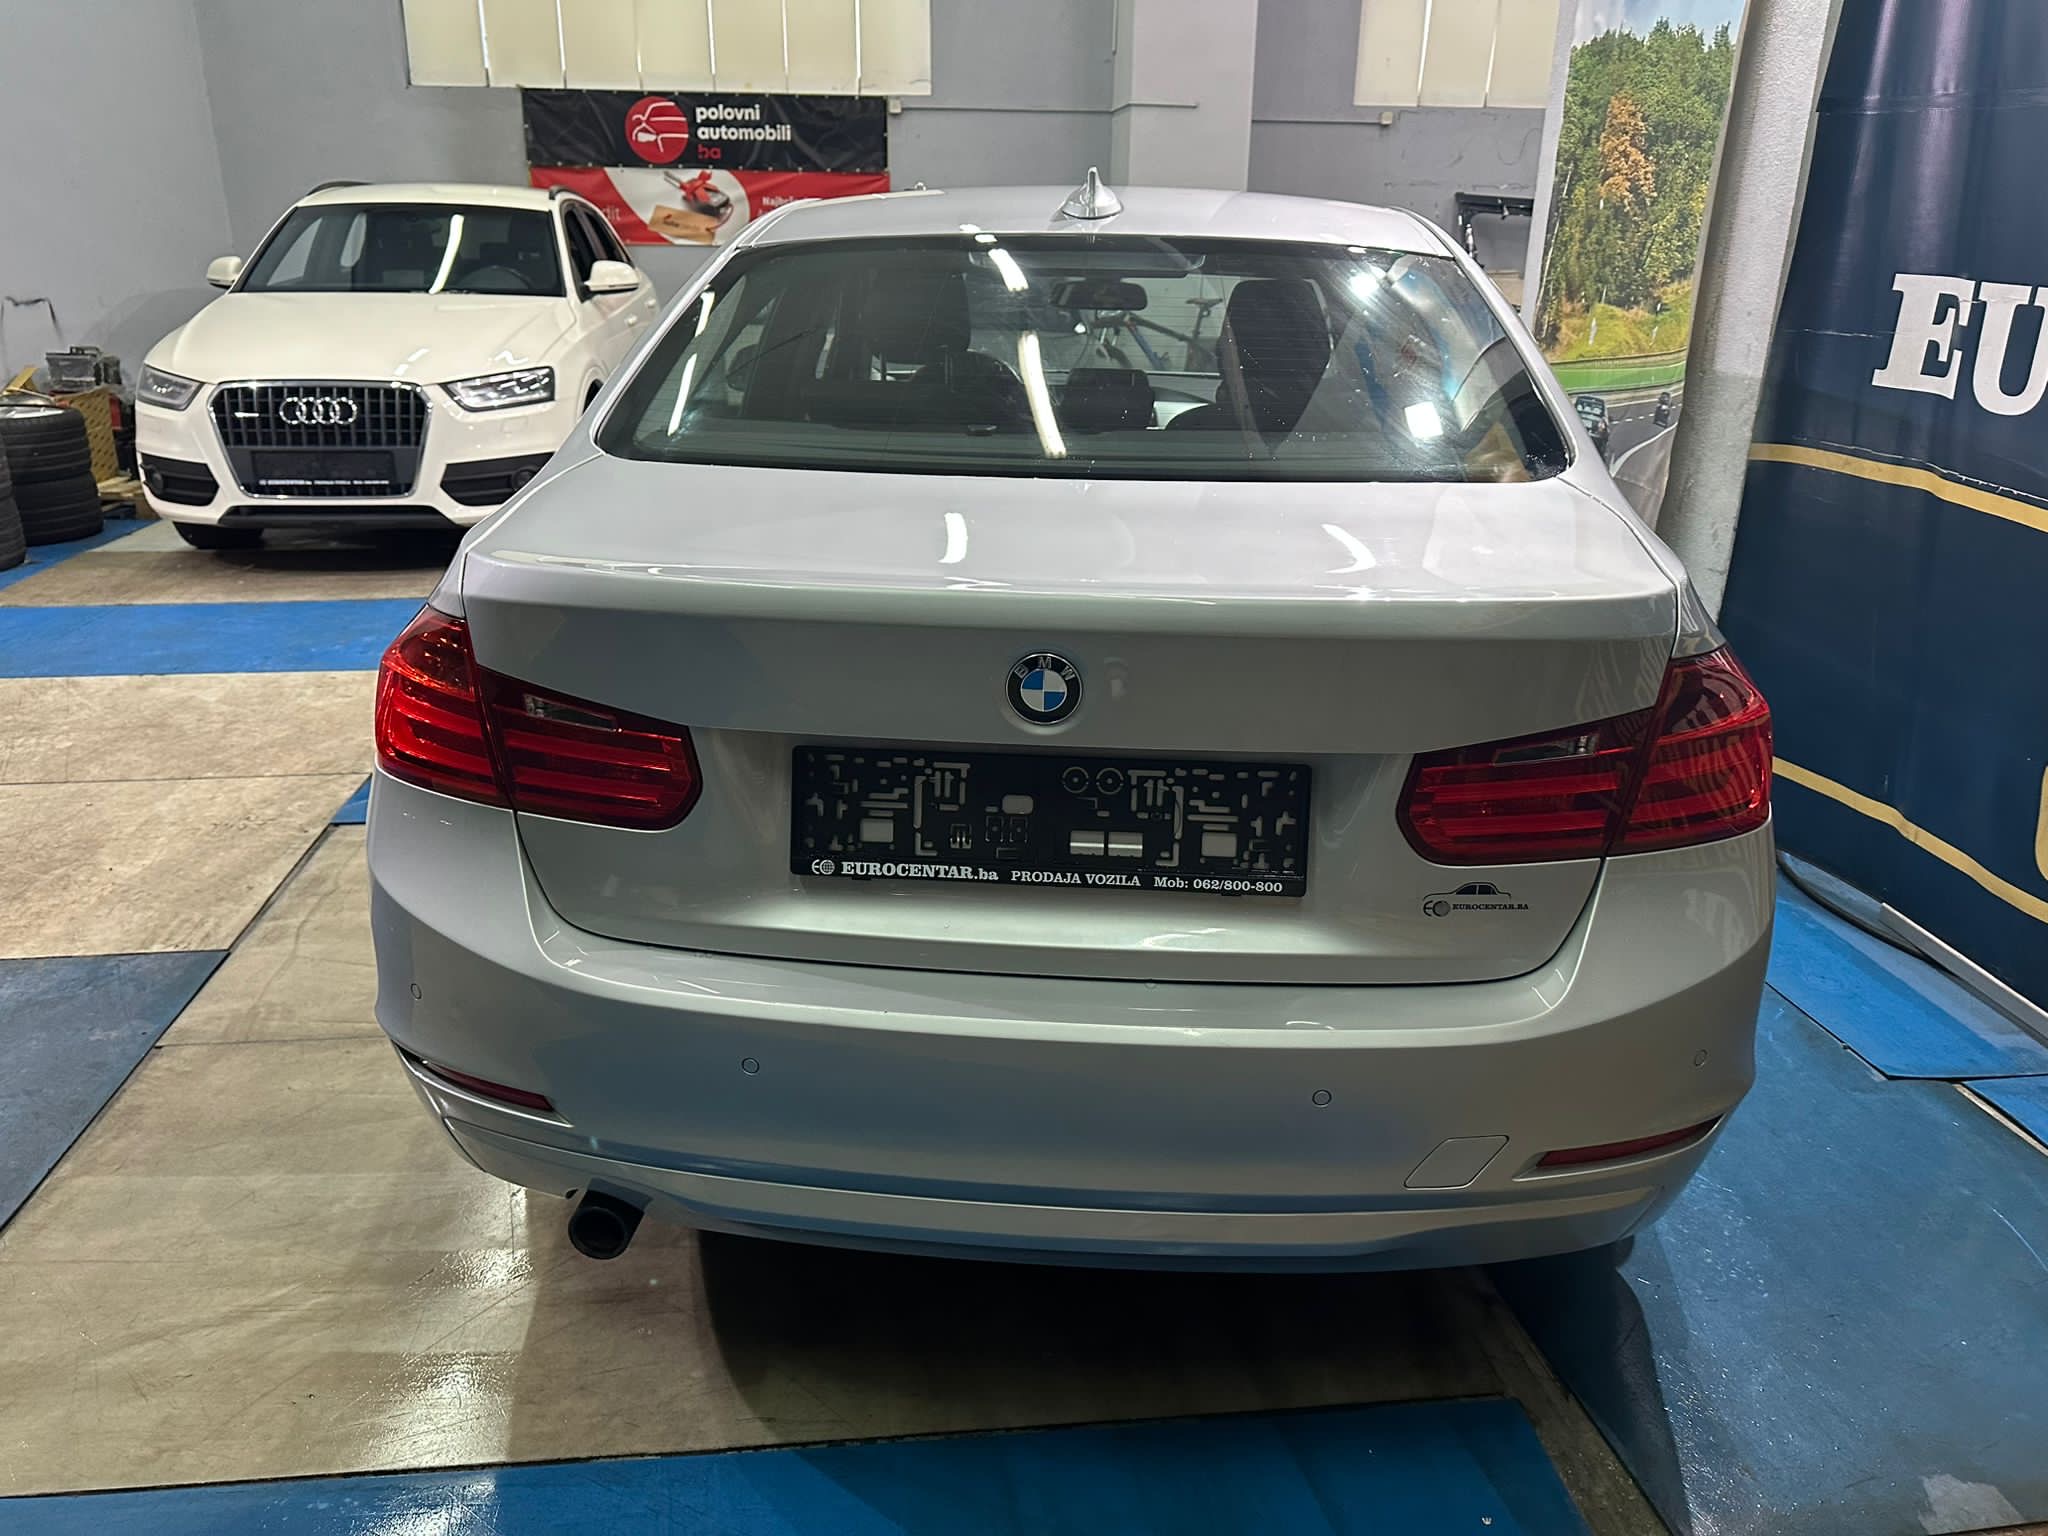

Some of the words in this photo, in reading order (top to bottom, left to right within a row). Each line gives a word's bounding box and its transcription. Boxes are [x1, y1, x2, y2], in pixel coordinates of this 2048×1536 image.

[696, 103, 760, 123] polovni
[697, 124, 791, 141] automobili
[1014, 656, 1076, 681] BMW
[841, 861, 999, 881] EUROCENTAR.ba
[1011, 870, 1081, 885] PRODAJA
[1085, 873, 1141, 887] VOZILA
[1154, 876, 1189, 889] Mob:
[1193, 878, 1282, 893] 062/800-800
[1452, 903, 1529, 911] EUROCENTAR.BA
